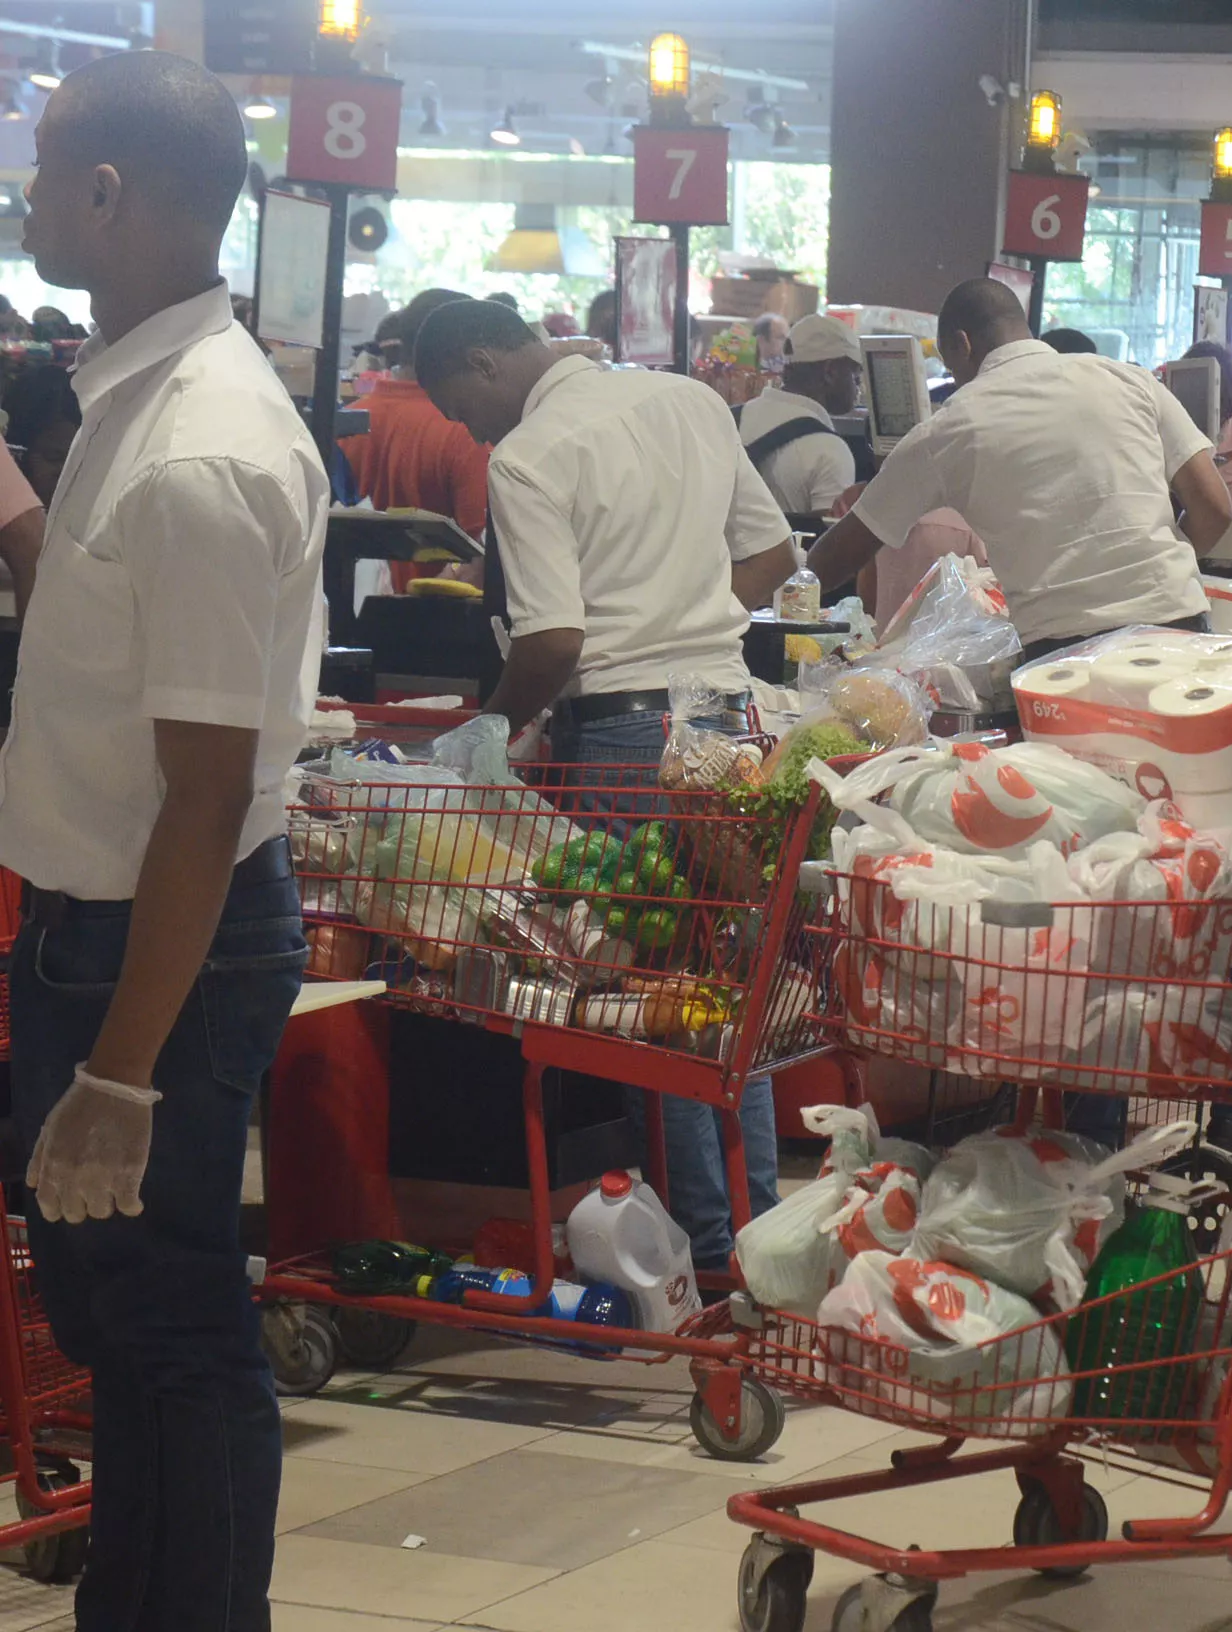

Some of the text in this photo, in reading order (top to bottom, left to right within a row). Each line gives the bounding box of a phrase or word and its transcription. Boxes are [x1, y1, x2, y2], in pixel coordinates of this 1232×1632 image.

[324, 101, 366, 158] 8
[665, 148, 697, 199] 7
[1031, 194, 1061, 239] 6
